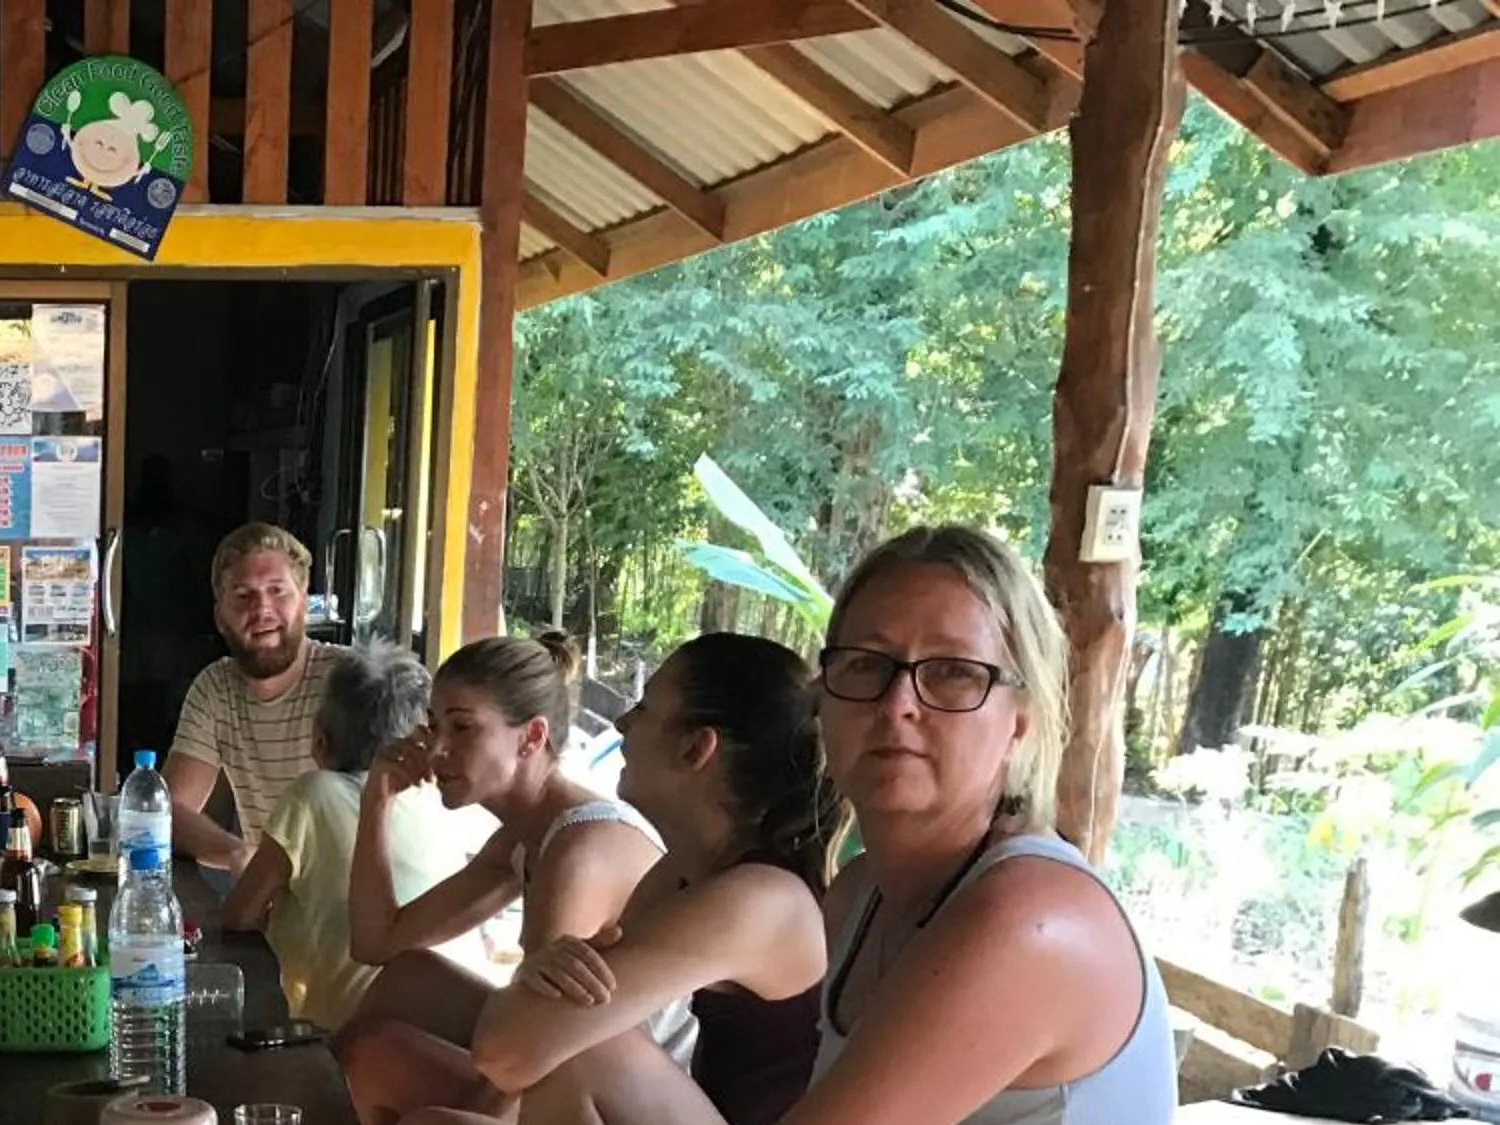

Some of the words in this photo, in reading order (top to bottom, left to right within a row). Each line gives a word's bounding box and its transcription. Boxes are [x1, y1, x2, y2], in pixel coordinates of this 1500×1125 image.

[36, 72, 84, 117] Clean
[86, 61, 137, 81] Food
[139, 73, 182, 117] Good
